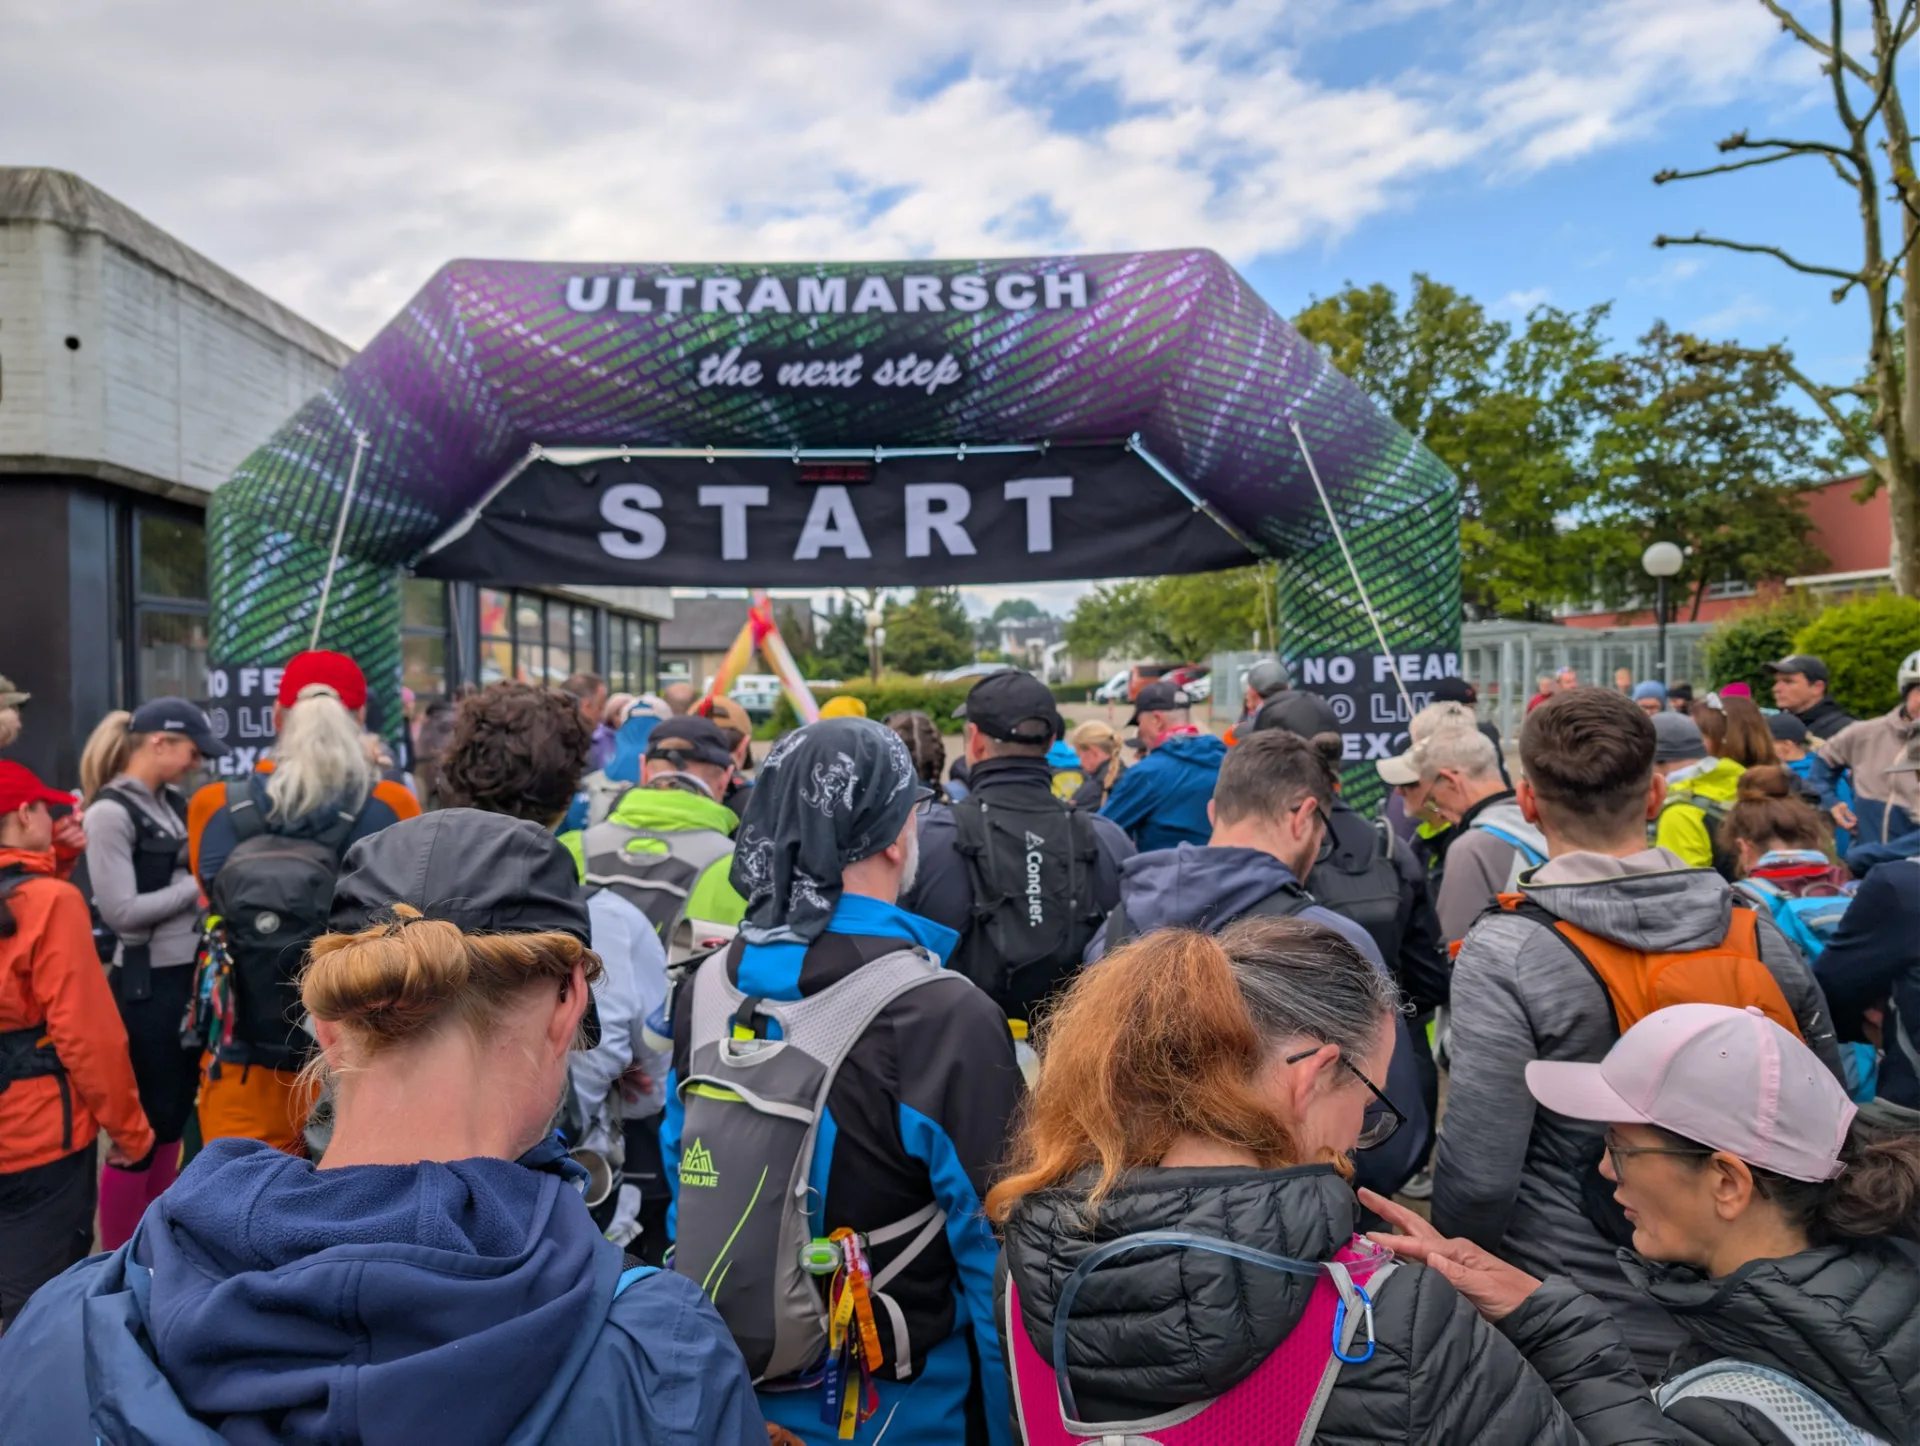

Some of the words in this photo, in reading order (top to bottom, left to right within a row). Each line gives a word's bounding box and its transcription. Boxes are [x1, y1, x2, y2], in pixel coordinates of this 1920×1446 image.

[566, 273, 1088, 313] ULTRAMARSCH
[698, 346, 763, 387] the
[776, 354, 863, 388] next
[872, 352, 962, 396] step
[598, 477, 1074, 561] START
[1303, 656, 1356, 684] NO
